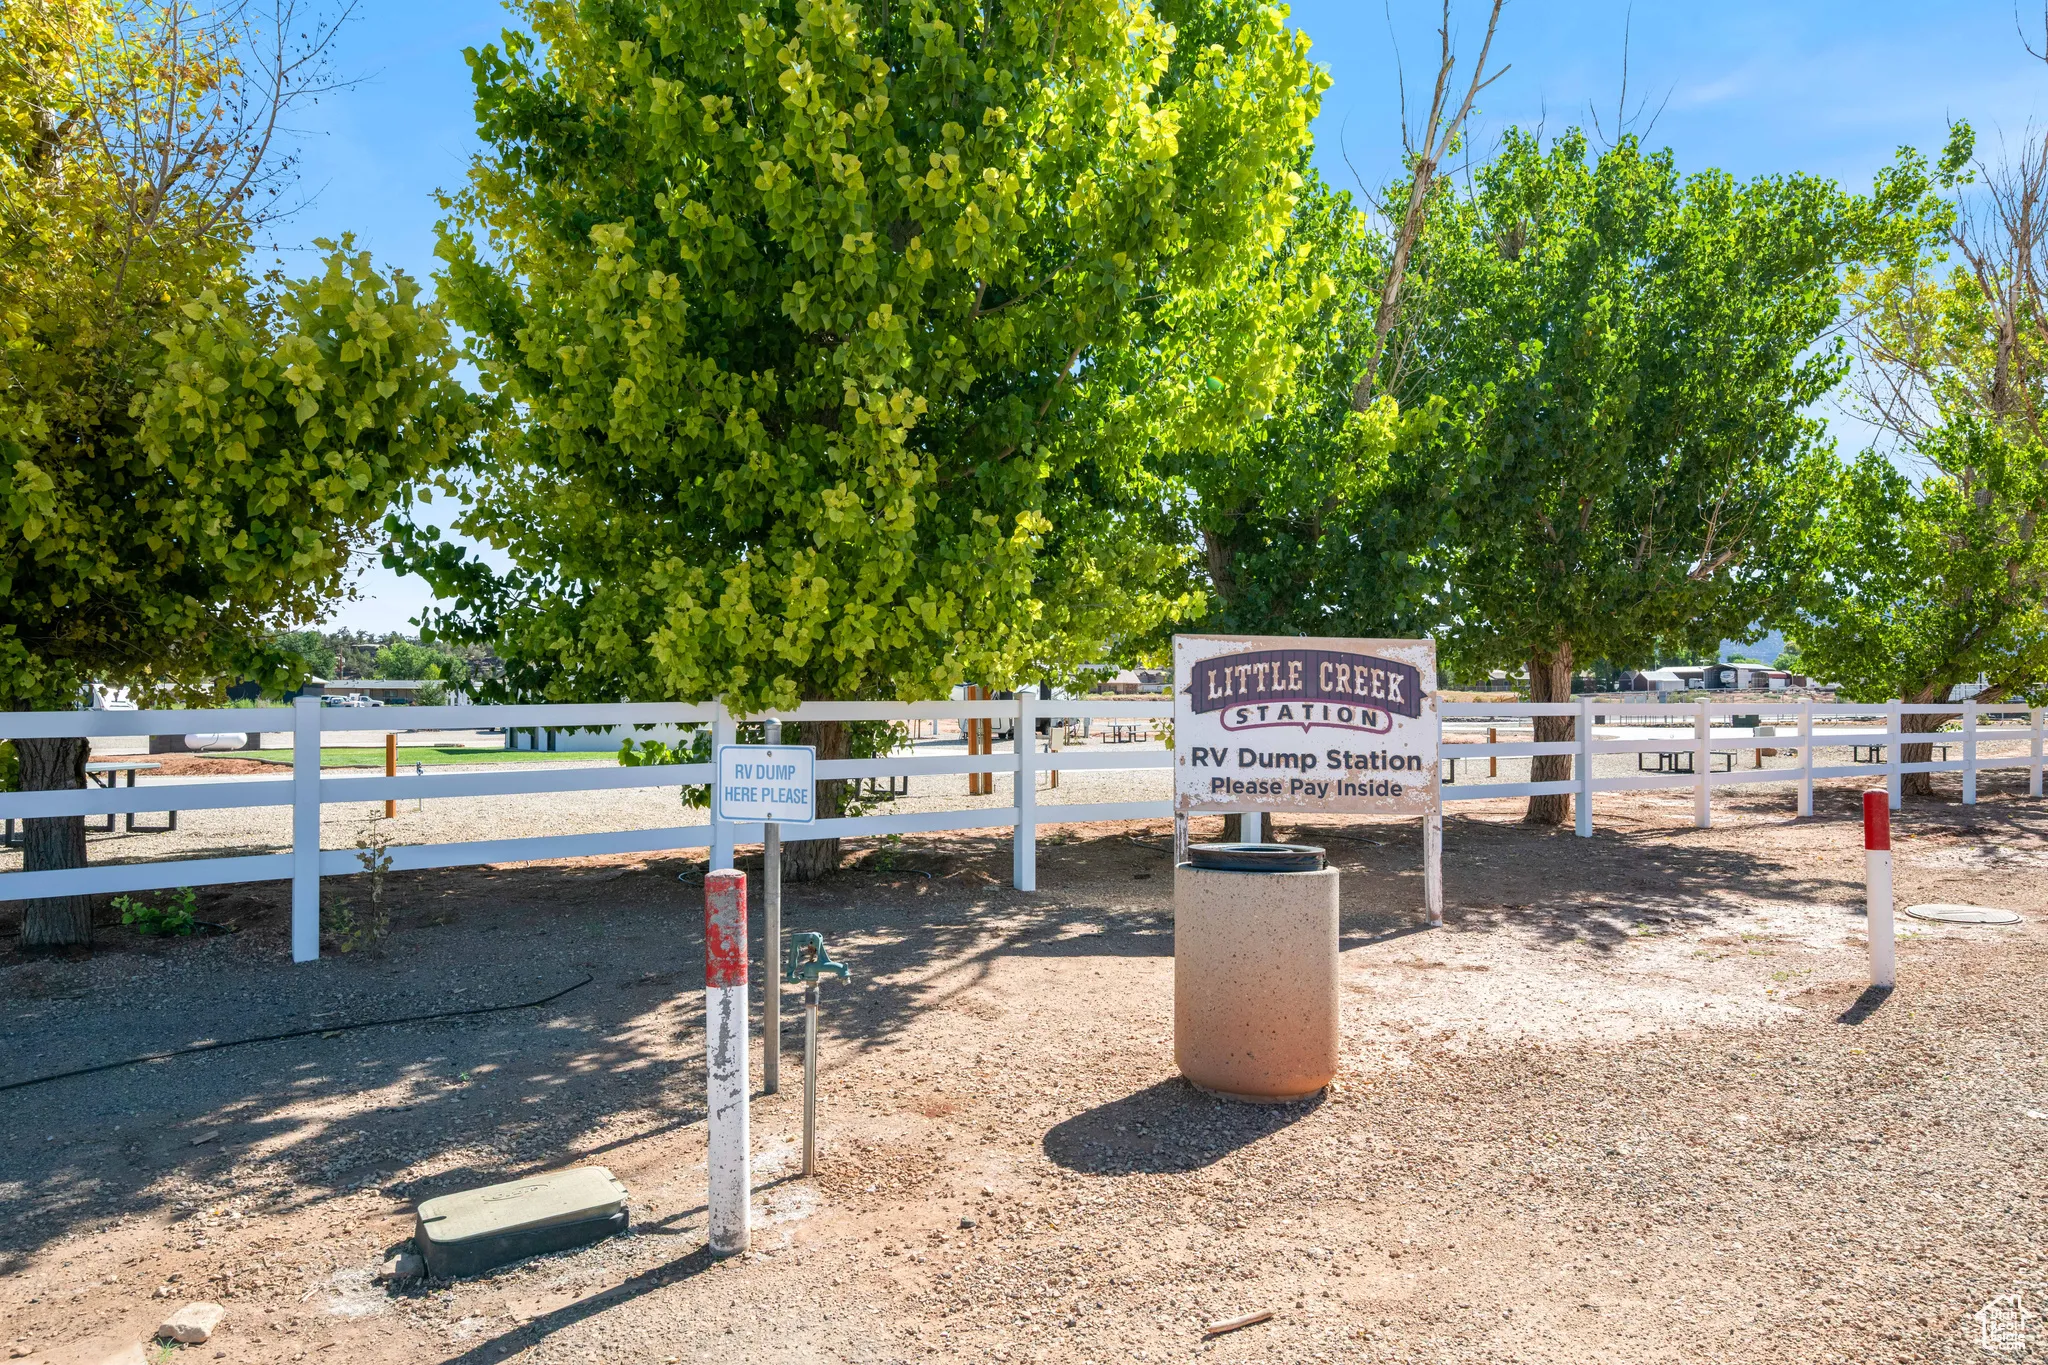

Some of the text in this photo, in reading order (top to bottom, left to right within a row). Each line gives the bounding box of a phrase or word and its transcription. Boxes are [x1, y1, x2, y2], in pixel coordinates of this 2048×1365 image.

[1207, 660, 1405, 704] LITTLE CREEK
[1236, 704, 1377, 727] STATION
[1192, 747, 1421, 772] RV Dump Station
[735, 764, 796, 780] RV DUMP
[725, 786, 808, 804] HERE PLEASE
[1211, 777, 1403, 799] Please Pay Inside
